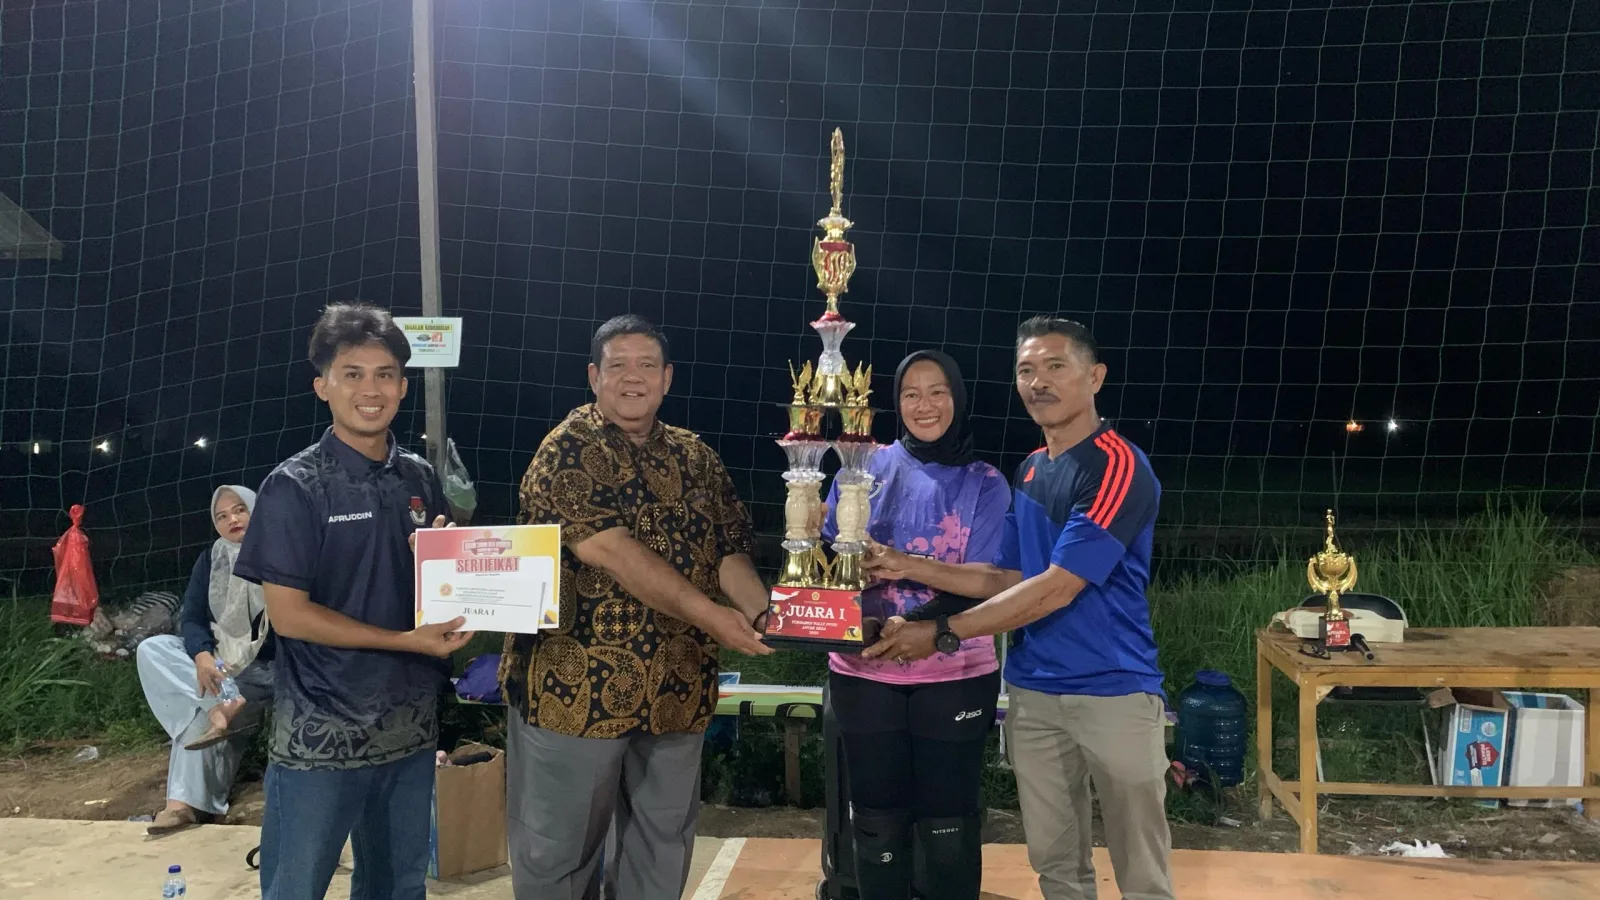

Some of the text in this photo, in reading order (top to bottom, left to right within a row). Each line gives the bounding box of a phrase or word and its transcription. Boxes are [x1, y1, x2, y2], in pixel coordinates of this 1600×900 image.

[328, 511, 372, 523] AFRUDDIN
[457, 557, 519, 572] SERTIFIKAT
[463, 607, 489, 615] JUARA
[786, 605, 845, 620] JUARA I
